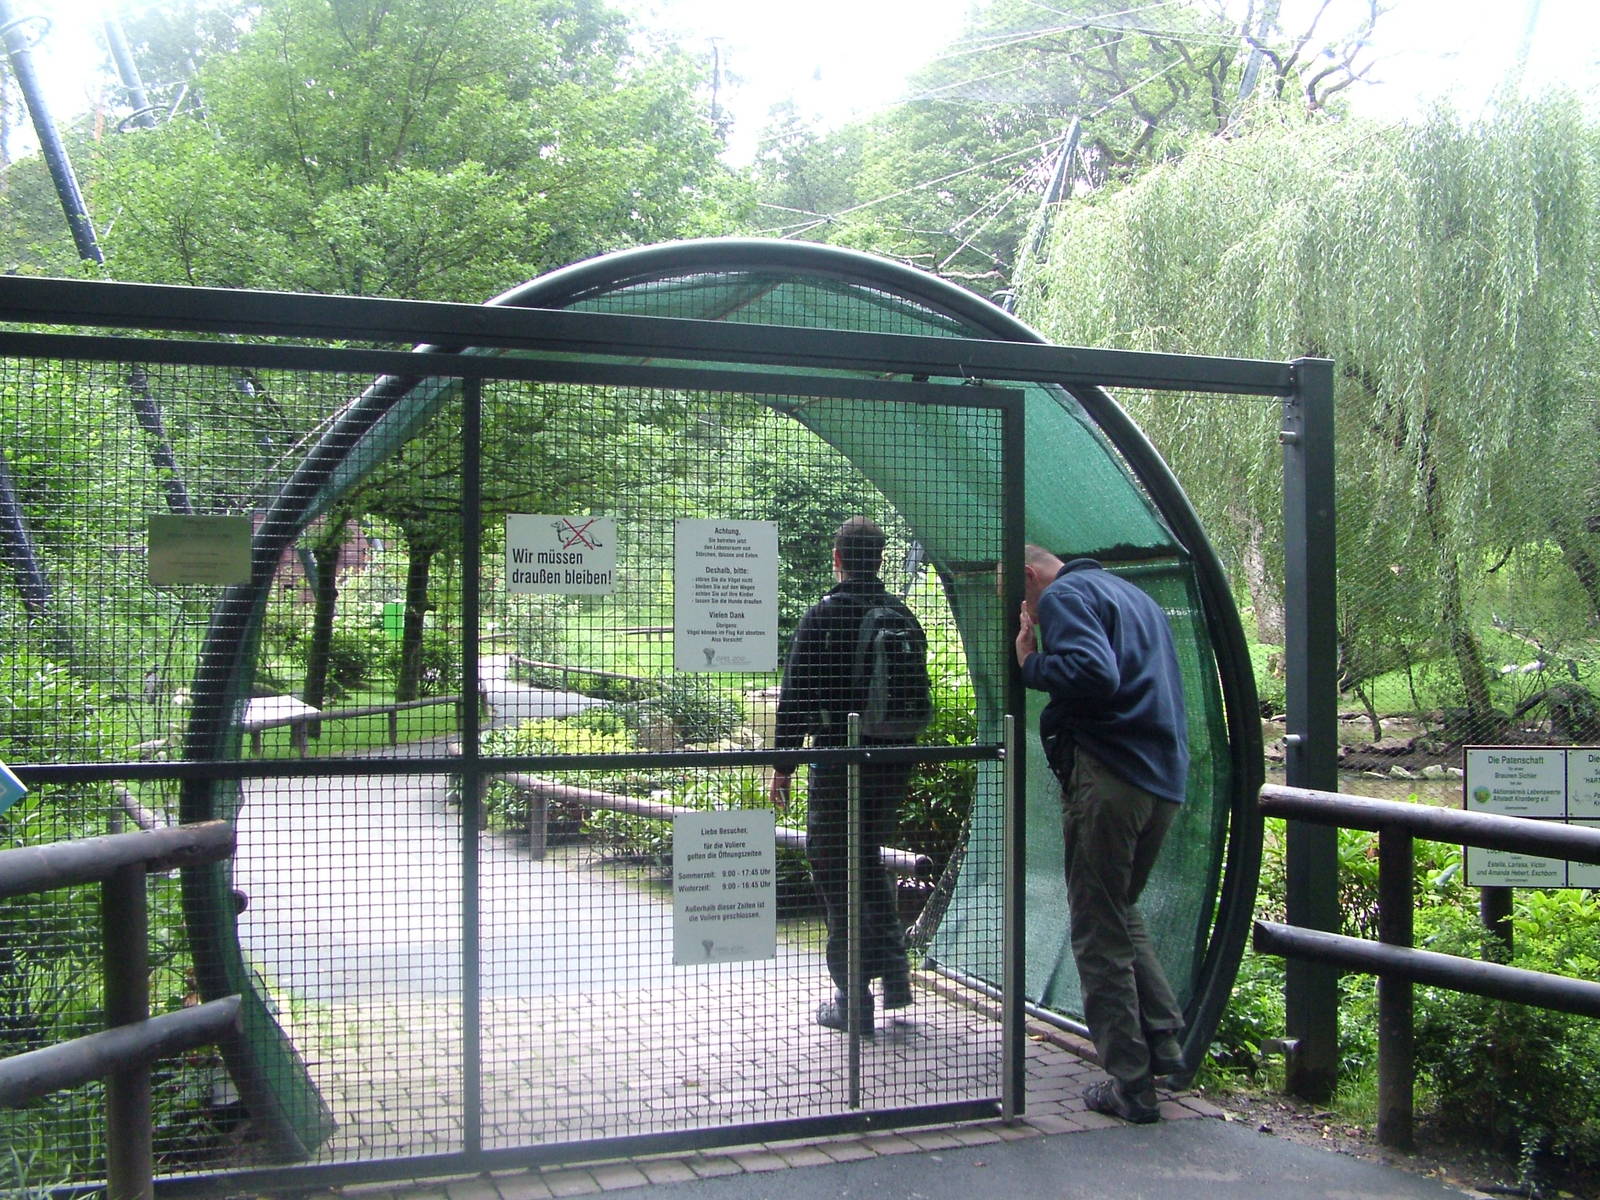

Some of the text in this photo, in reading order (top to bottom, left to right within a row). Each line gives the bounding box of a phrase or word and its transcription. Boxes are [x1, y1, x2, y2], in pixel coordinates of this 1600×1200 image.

[714, 528, 741, 536] Achtung,
[512, 548, 583, 564] Wir müssen
[512, 568, 612, 584] draußen bleiben!
[1488, 756, 1544, 764] Die Patenschaft
[688, 853, 706, 861] gelten
[718, 850, 762, 859] Öffnungszeiten
